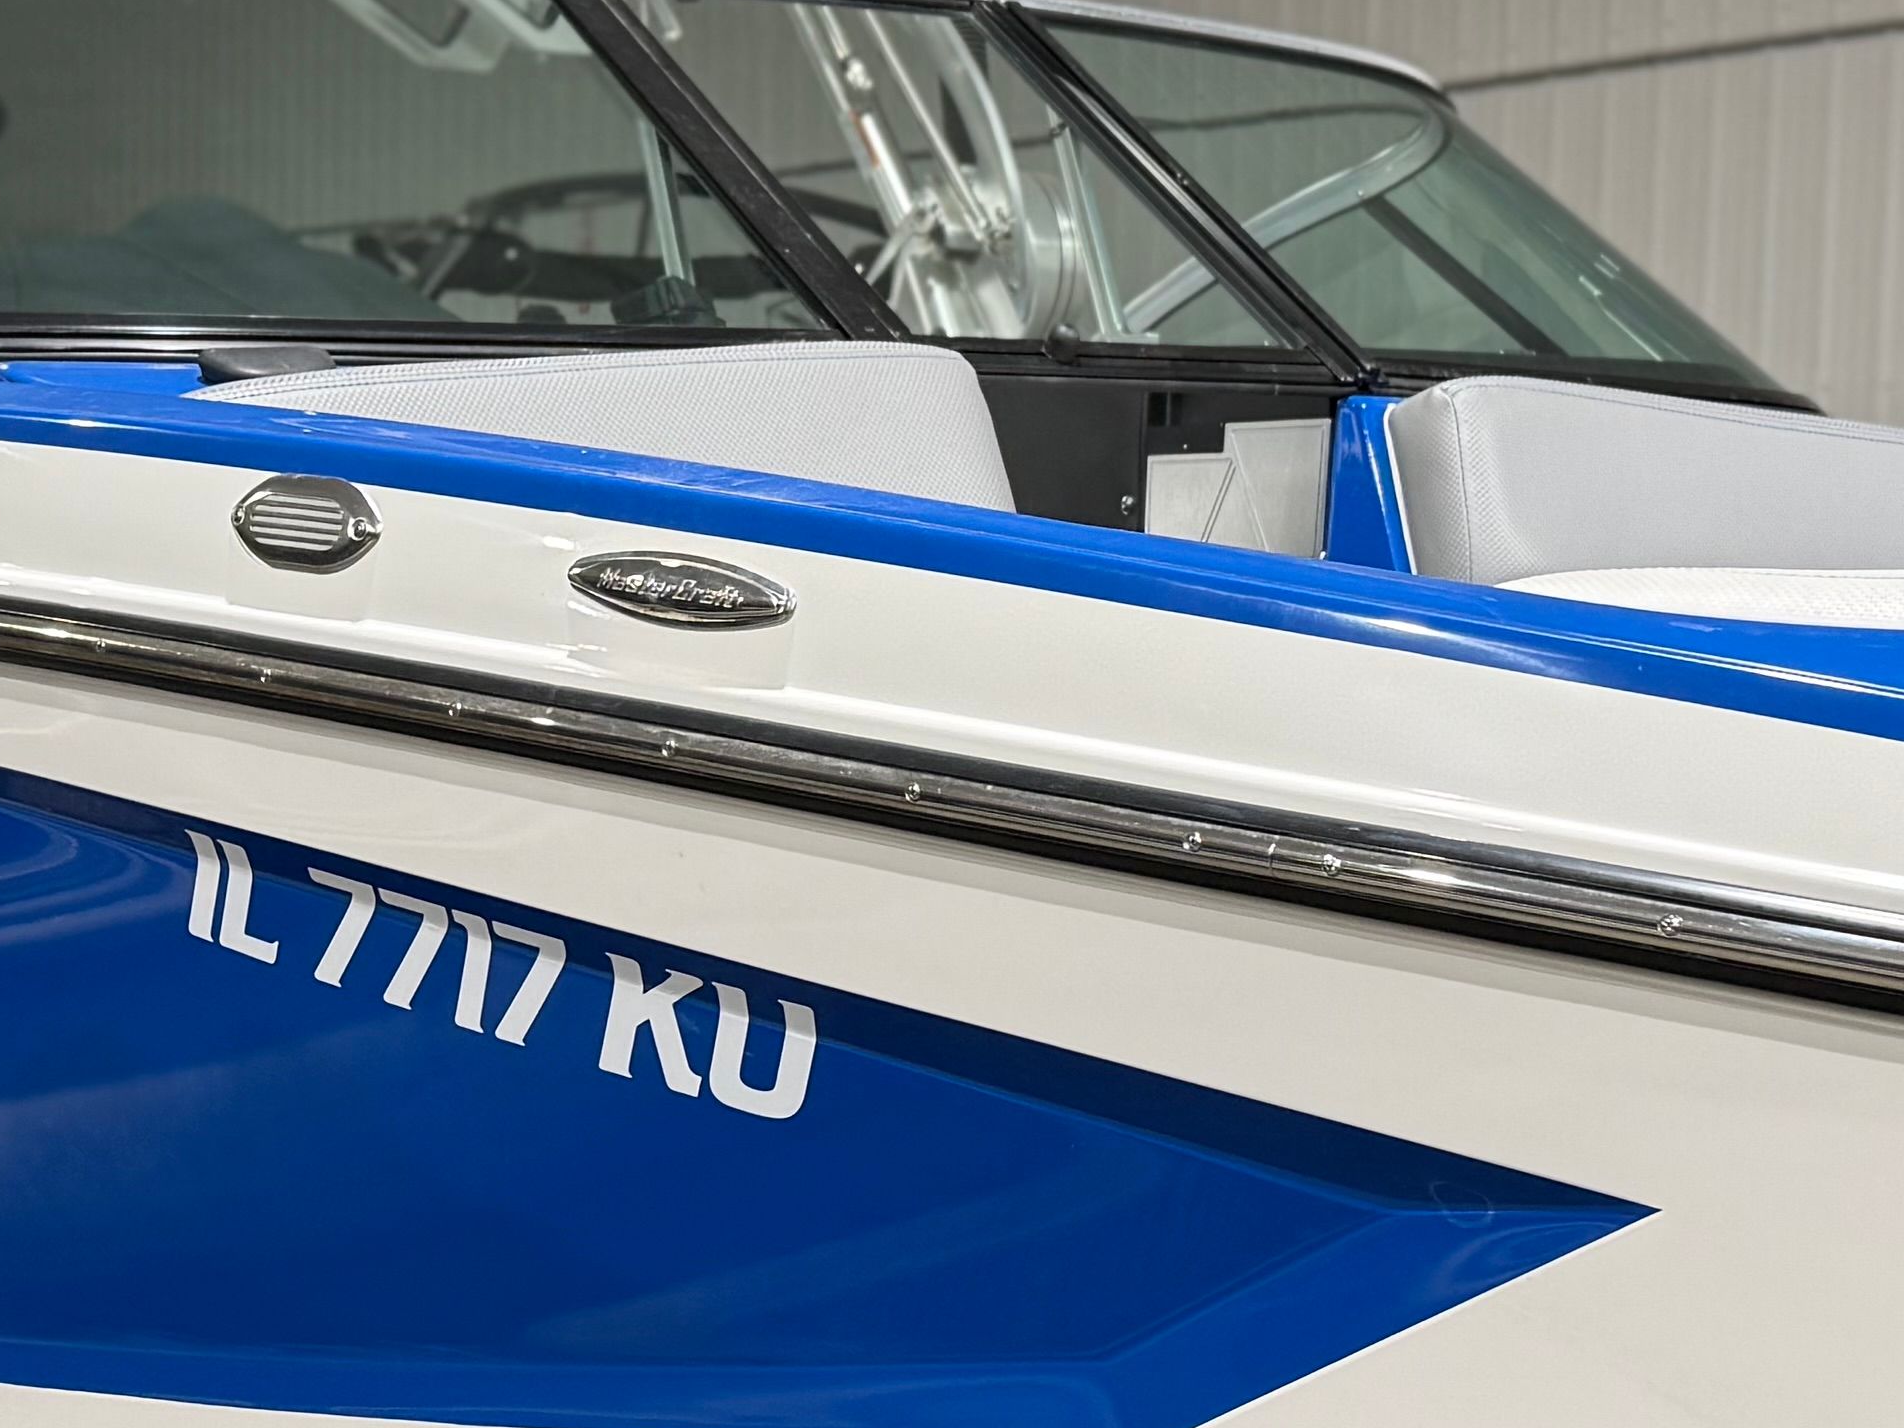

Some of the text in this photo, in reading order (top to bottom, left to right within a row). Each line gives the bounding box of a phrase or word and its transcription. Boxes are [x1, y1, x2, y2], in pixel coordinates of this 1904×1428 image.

[597, 567, 745, 608] MasterCraft
[185, 829, 817, 1120] IL 7717 KU
